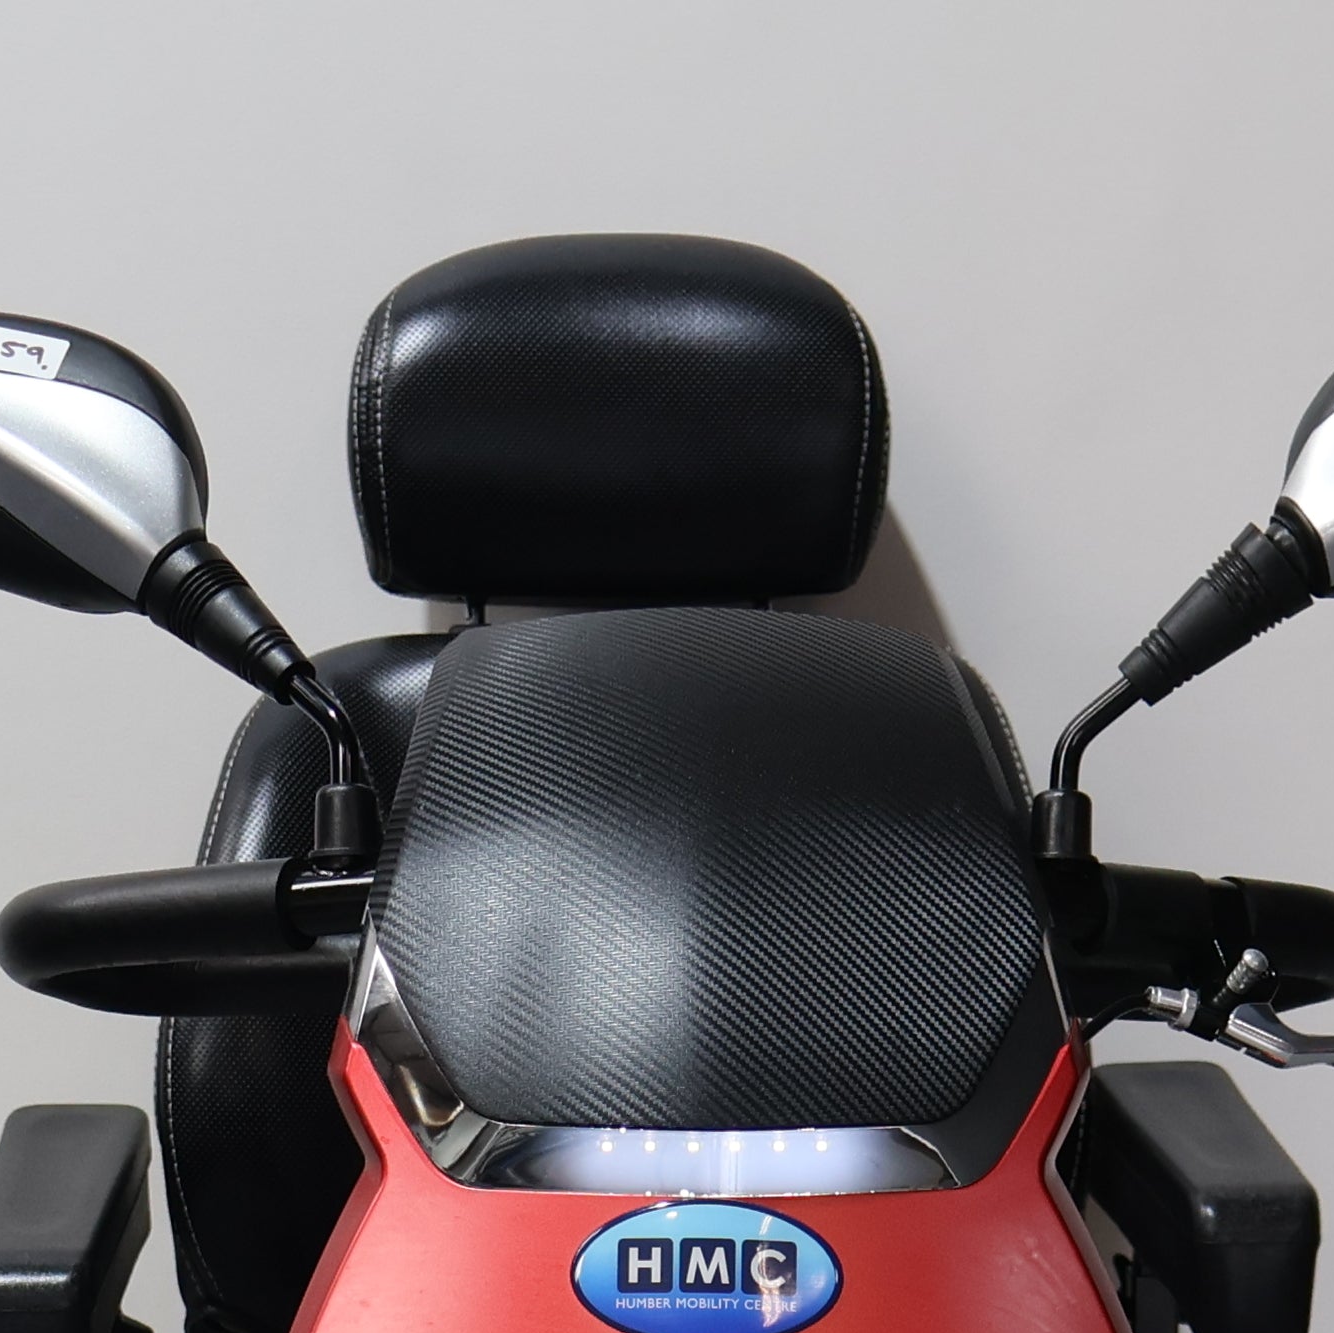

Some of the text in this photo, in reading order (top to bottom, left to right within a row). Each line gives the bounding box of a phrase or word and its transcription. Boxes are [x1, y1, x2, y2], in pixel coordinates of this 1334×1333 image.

[628, 1246, 787, 1288] HMC
[616, 1298, 671, 1309] HUMBER
[676, 1298, 739, 1310] MOBILITY
